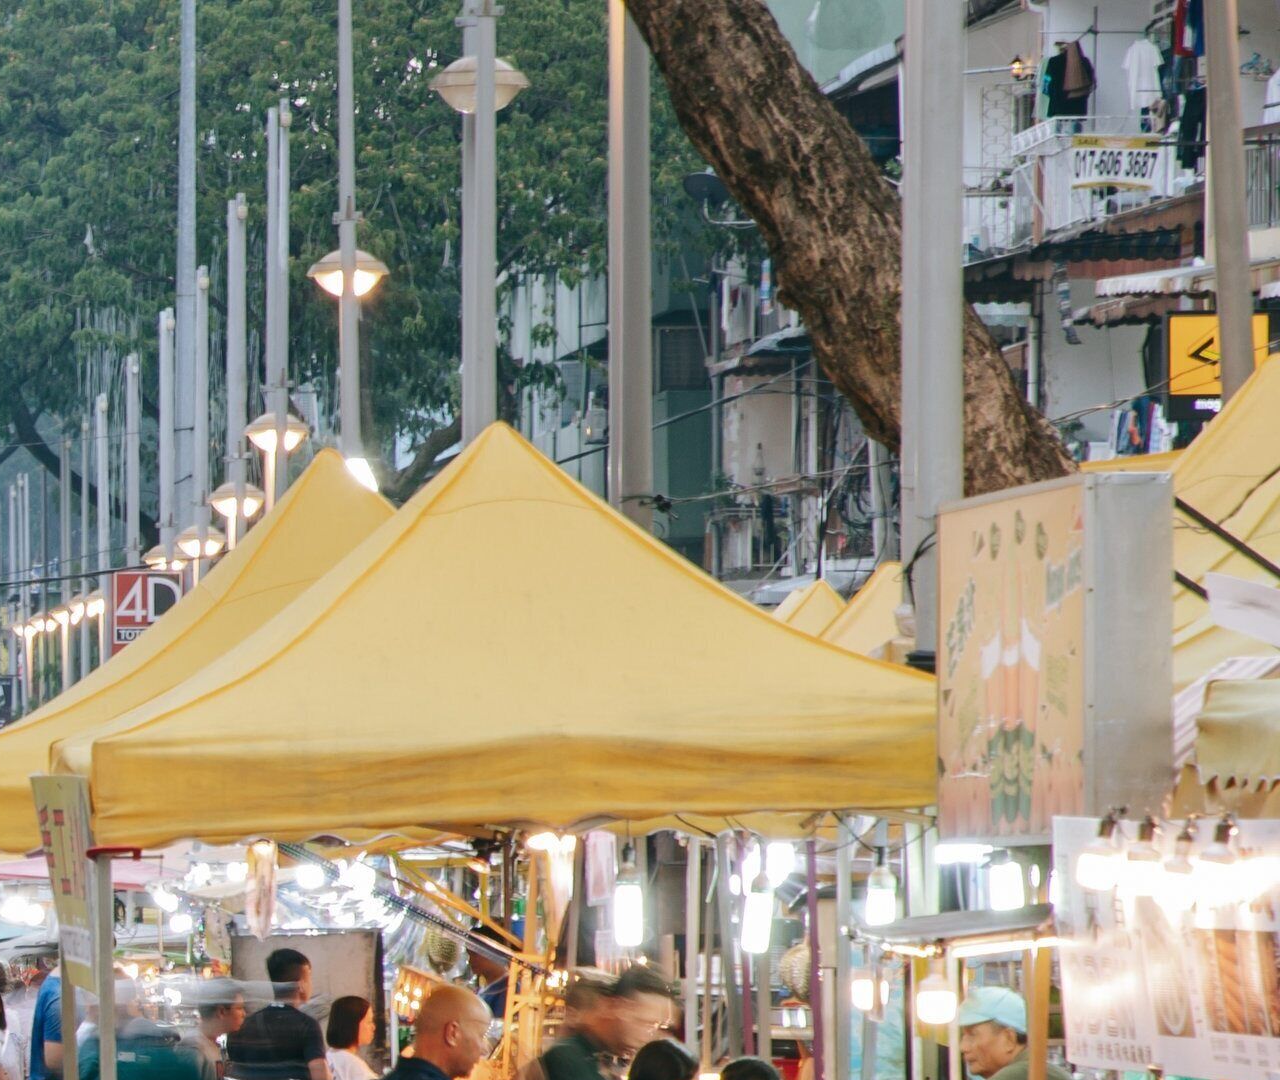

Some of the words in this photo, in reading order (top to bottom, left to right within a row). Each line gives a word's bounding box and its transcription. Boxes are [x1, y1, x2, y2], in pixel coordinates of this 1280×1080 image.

[1125, 151, 1158, 179] 3687
[1194, 398, 1221, 413] mag
[116, 575, 182, 623] 4D
